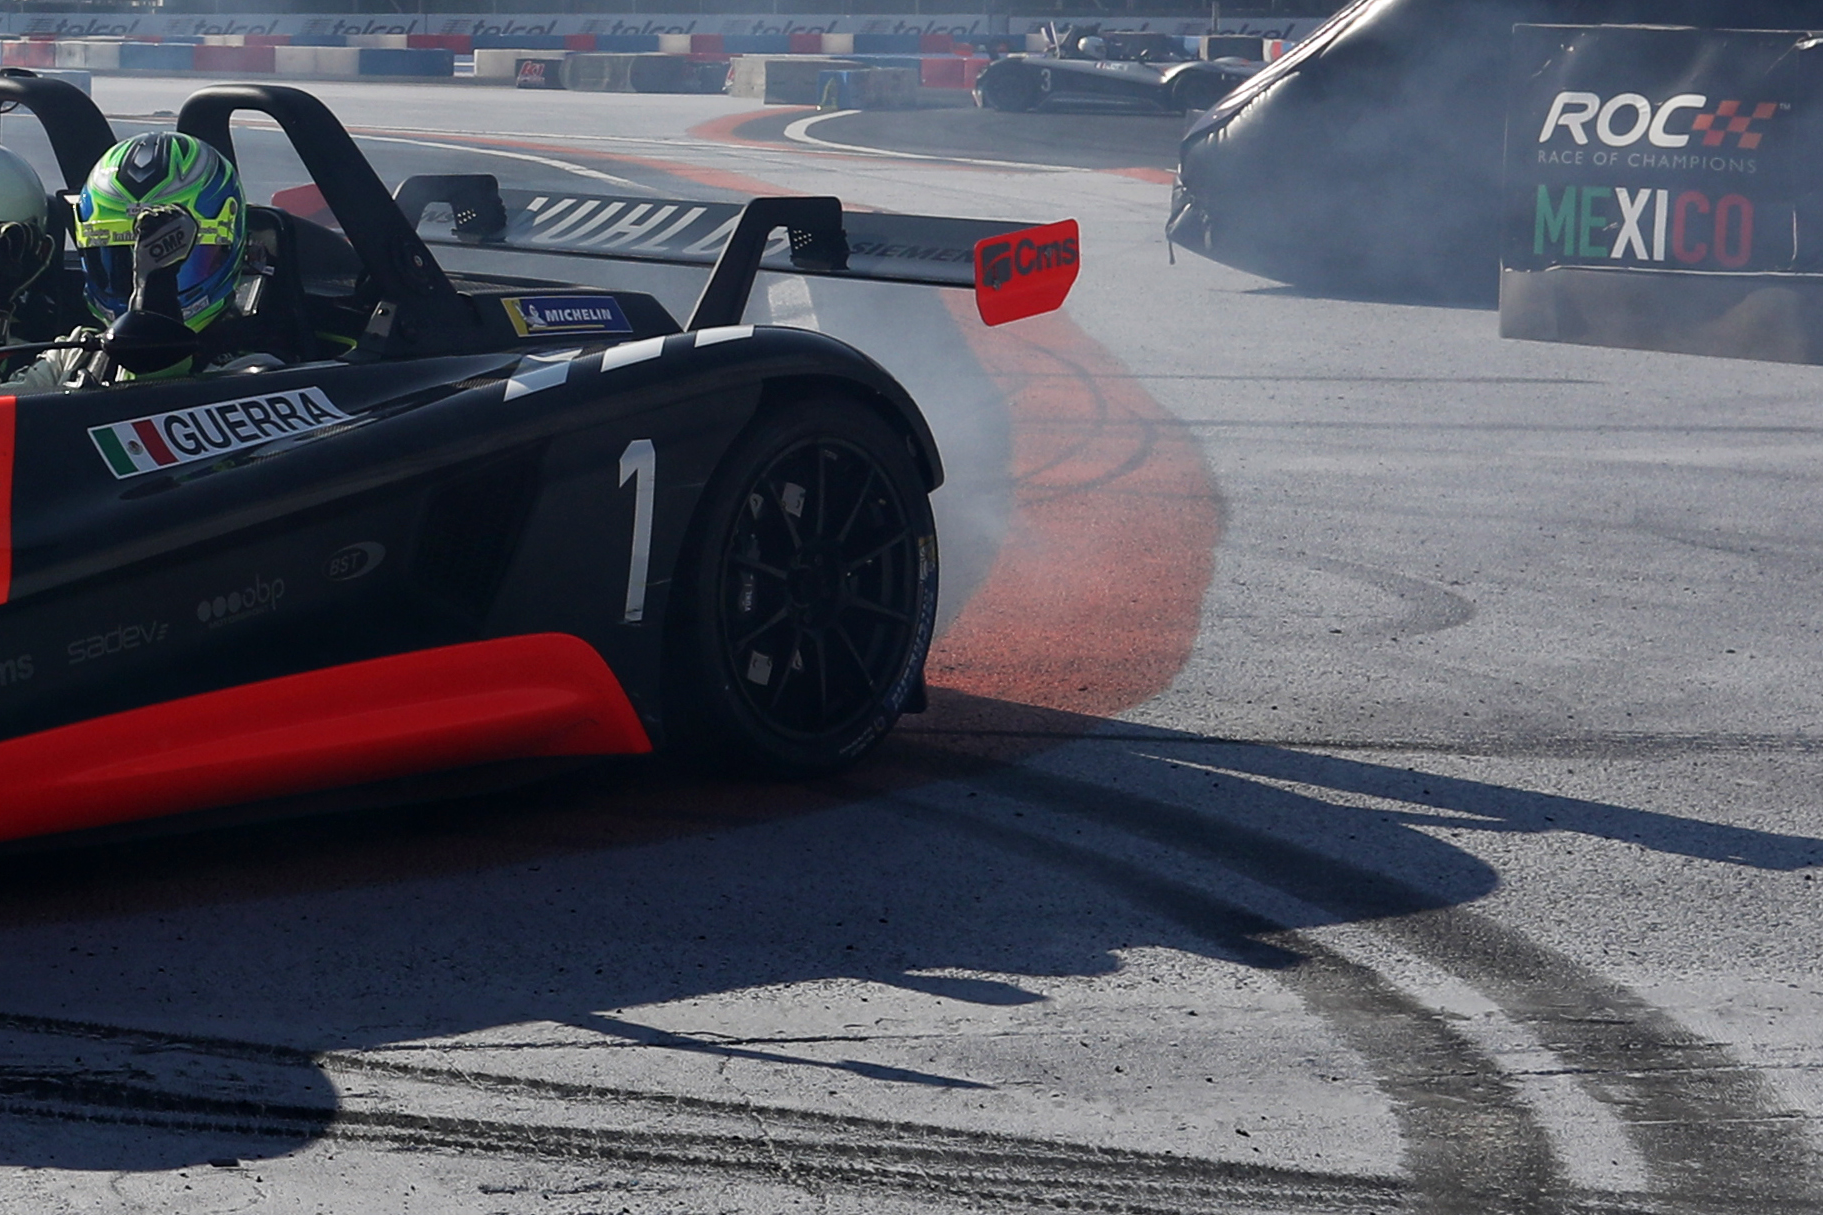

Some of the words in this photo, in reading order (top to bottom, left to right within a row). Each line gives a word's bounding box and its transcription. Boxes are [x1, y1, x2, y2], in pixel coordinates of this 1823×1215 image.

[1040, 68, 1052, 92] 3
[1538, 91, 1707, 148] ROC
[1537, 149, 1583, 166] RACE
[1593, 150, 1619, 166] OF
[1627, 152, 1757, 175] CHAMPIONS
[1533, 184, 1755, 268] MEXICO
[149, 229, 187, 259] OMP
[849, 242, 977, 265] SIEMEN
[1014, 237, 1077, 277] Cms
[544, 308, 612, 322] MICHELIN
[162, 391, 340, 456] GUERRA
[618, 439, 657, 624] 1
[328, 551, 362, 576] BST
